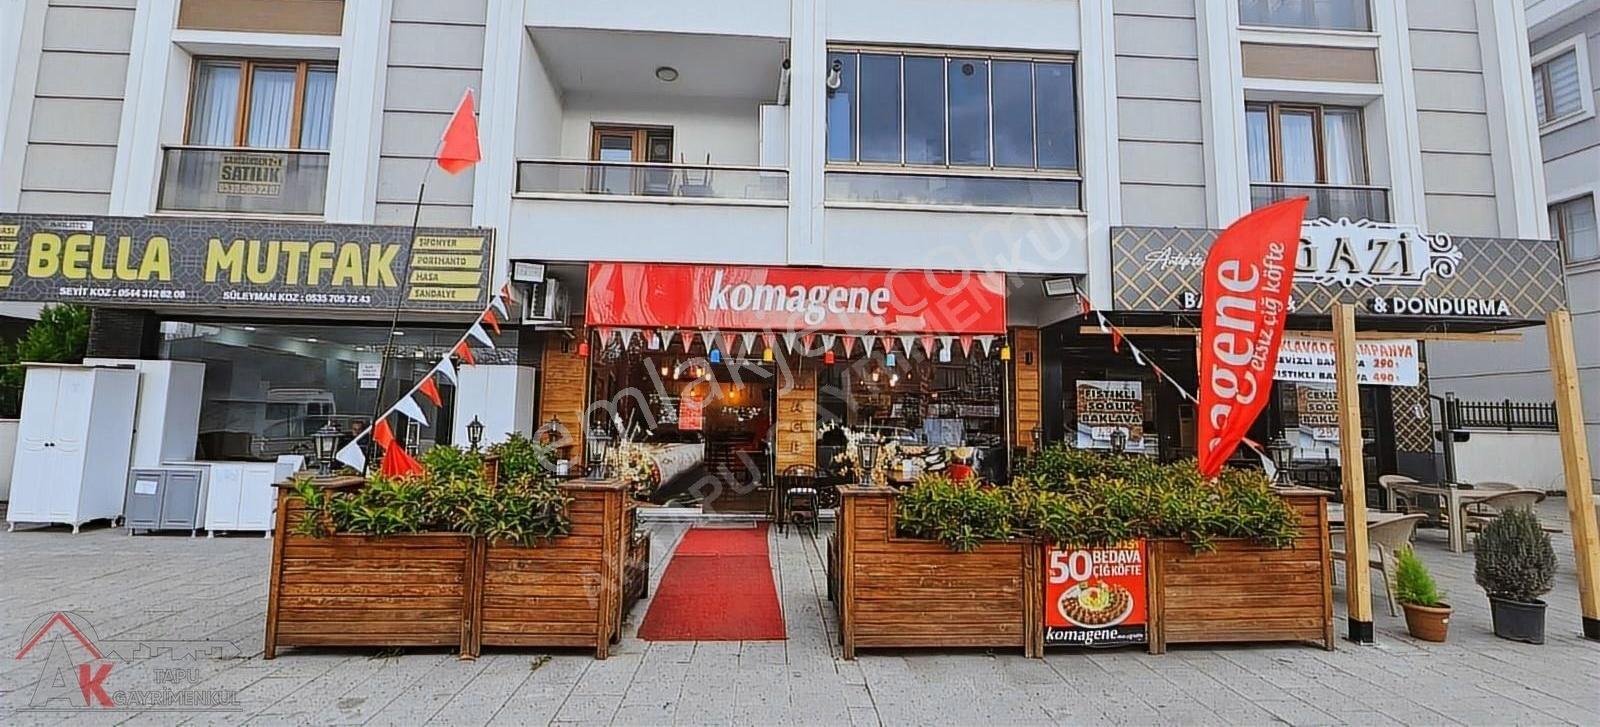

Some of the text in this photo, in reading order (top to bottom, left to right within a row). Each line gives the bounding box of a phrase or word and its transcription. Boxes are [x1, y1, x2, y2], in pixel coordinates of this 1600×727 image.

[222, 165, 280, 181] SATILIK
[27, 232, 401, 287] BELLA MUTFAK
[1261, 242, 1286, 294] köfte
[59, 284, 89, 297] SEYİT
[90, 288, 111, 297] KOZ
[223, 289, 276, 301] SÜLEYMAN
[278, 292, 300, 302] KOZ
[414, 289, 457, 299] SANDALYE
[708, 269, 891, 326] komagene
[1373, 296, 1388, 314] &
[1393, 296, 1511, 316] DONDURMA
[1209, 259, 1260, 453] agene
[1357, 344, 1413, 358] MPANYA
[1082, 413, 1142, 423] BAKLAVA
[1092, 550, 1142, 564] BEDAVA
[1111, 564, 1142, 576] KÖFTE
[1045, 626, 1118, 645] komagene
